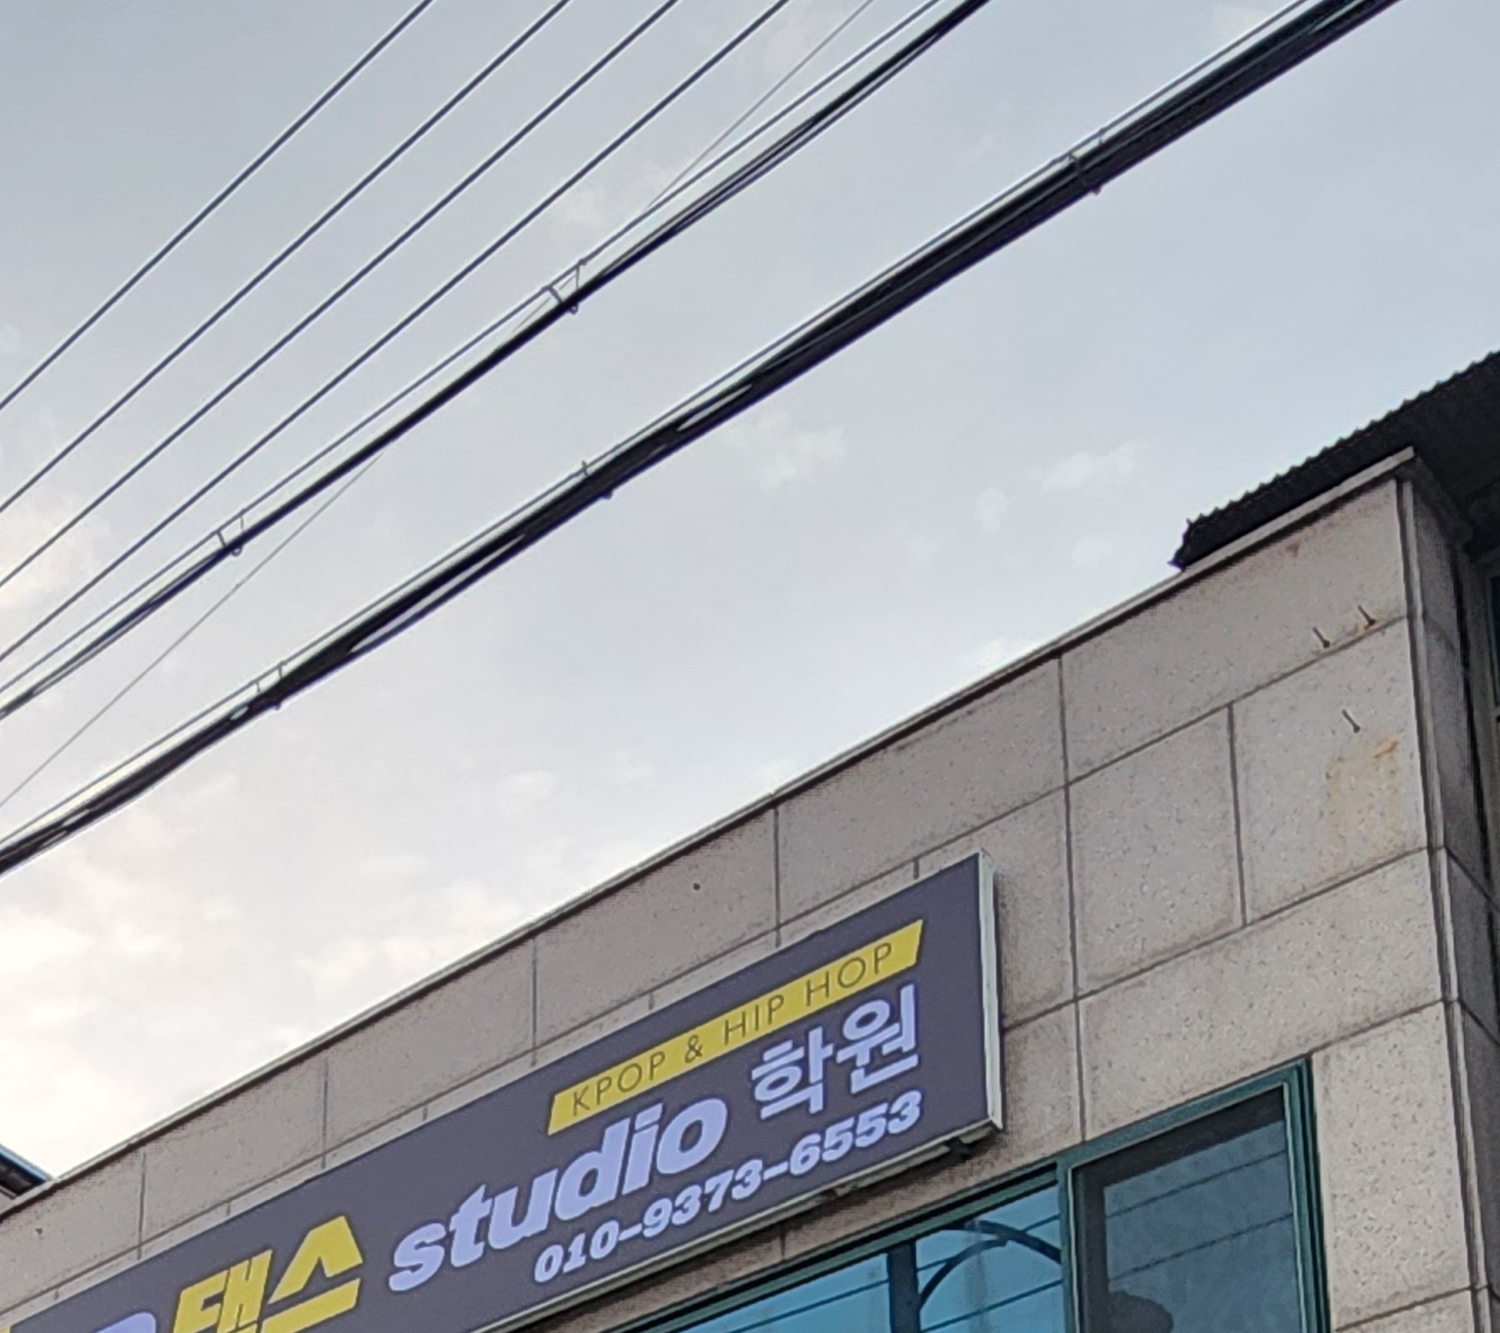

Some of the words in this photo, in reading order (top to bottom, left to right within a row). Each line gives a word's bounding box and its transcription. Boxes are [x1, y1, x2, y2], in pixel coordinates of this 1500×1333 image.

[571, 1050, 668, 1117] KPOP
[683, 1034, 704, 1065] &
[723, 993, 786, 1045] HIP
[804, 942, 894, 1007] HOP
[387, 1097, 728, 1292] studio
[751, 982, 920, 1120] 학원
[533, 1089, 923, 1284] 010-9373-6553
